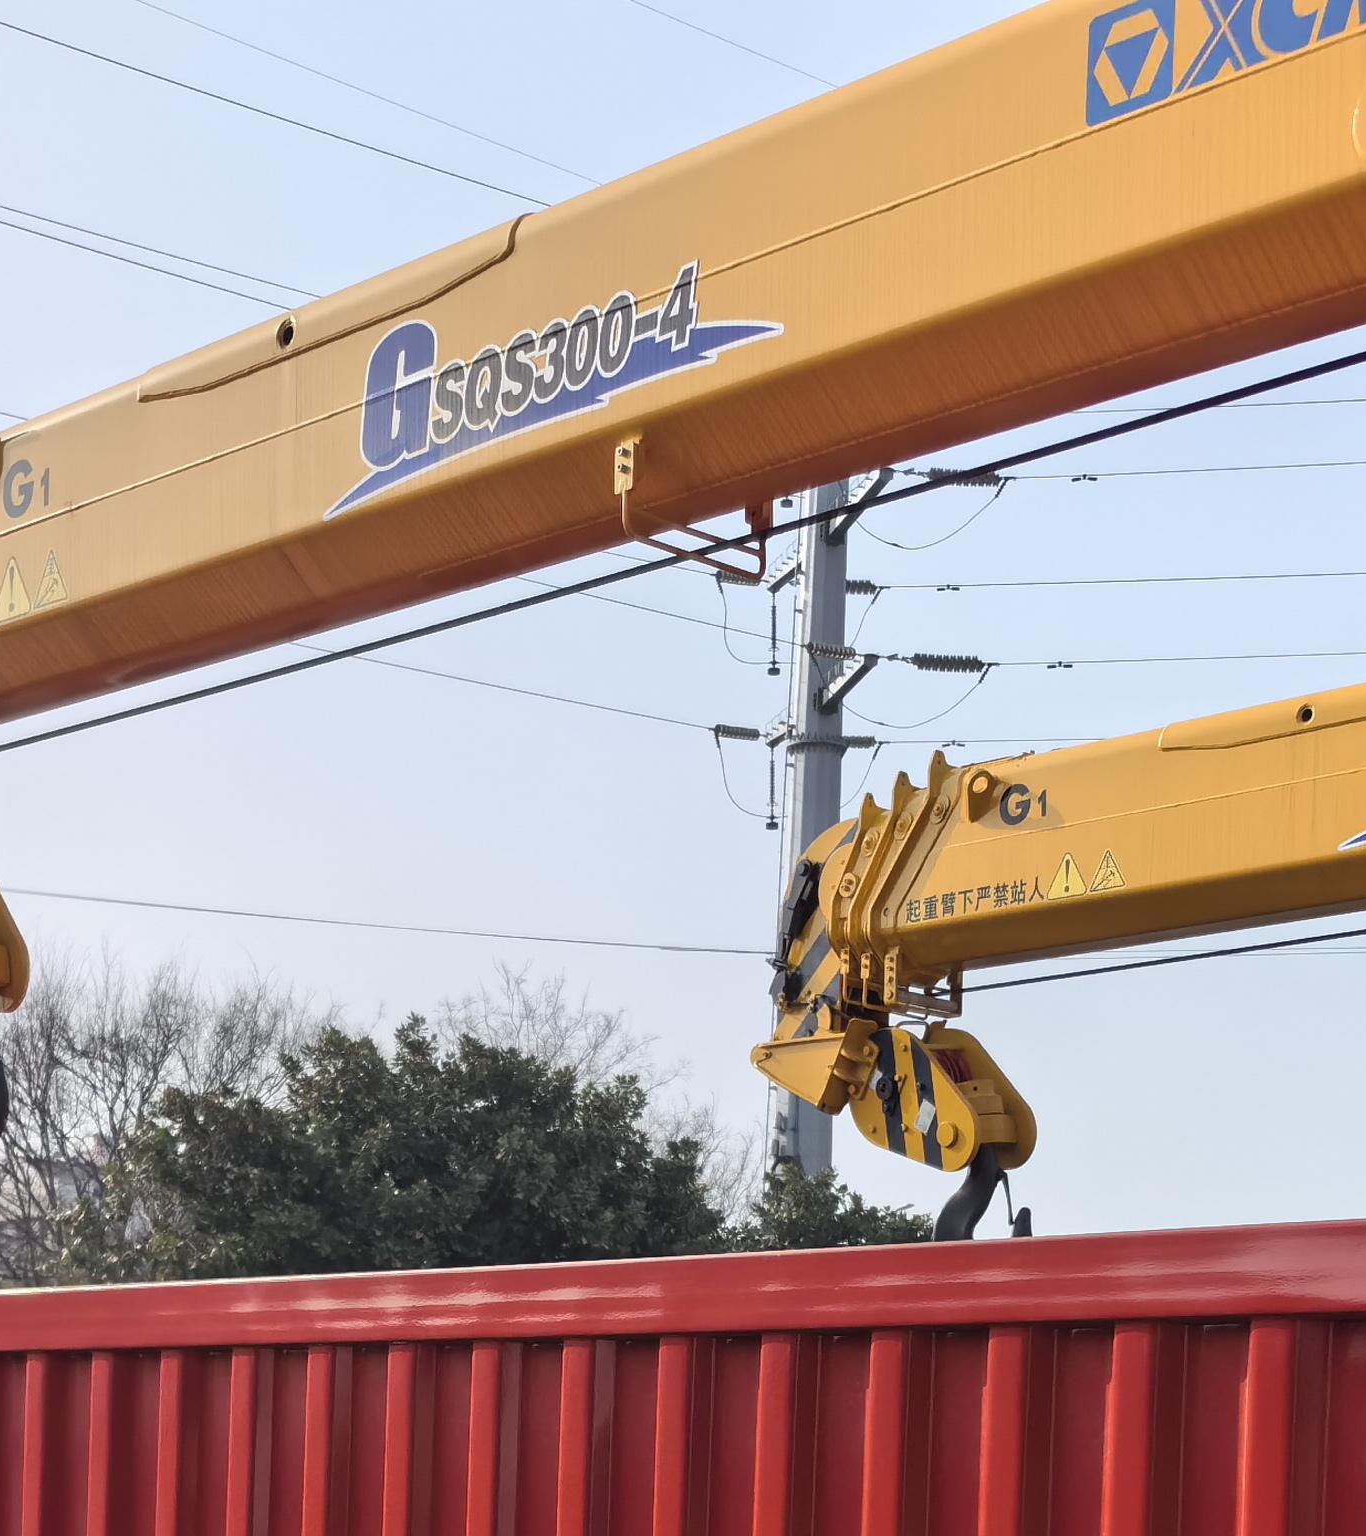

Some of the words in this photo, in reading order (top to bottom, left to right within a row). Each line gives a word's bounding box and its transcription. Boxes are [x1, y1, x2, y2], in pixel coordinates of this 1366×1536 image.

[362, 260, 699, 470] GSQS300-4
[3, 459, 51, 518] G1
[999, 783, 1047, 826] G1
[905, 875, 1045, 924] 起重臂下严禁站人
